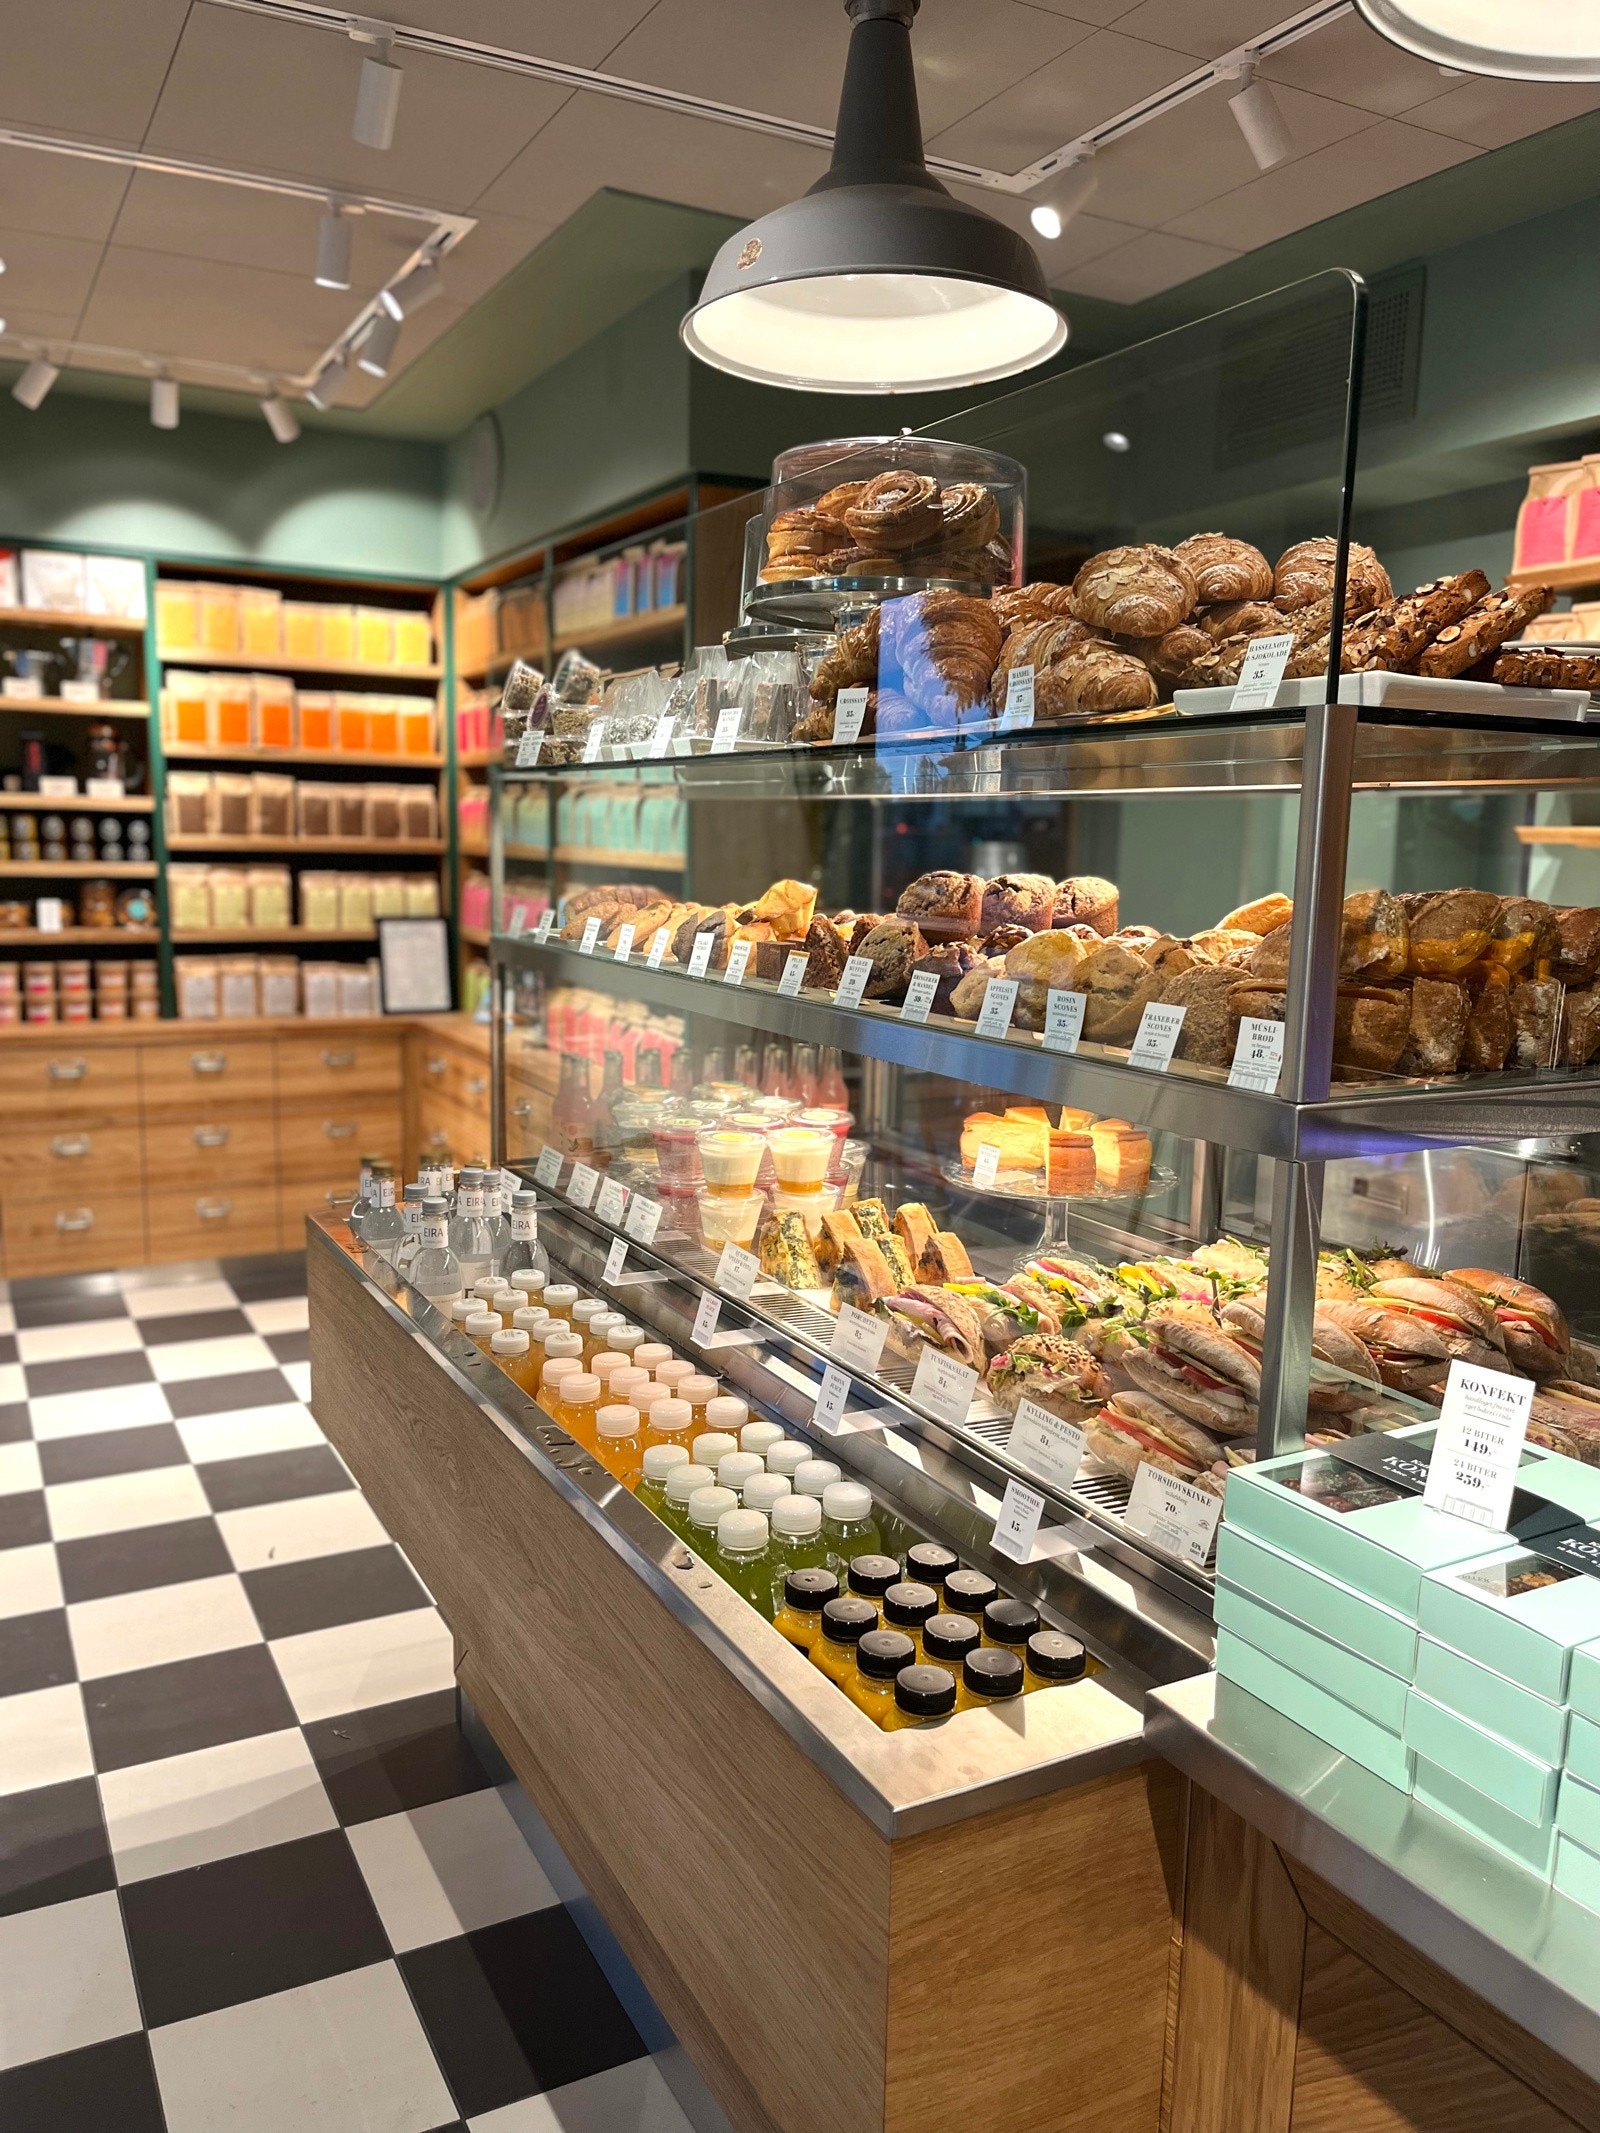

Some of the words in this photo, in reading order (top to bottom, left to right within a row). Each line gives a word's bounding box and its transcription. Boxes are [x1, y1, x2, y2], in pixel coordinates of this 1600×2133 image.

[1251, 650, 1288, 660] SJOKOLADE
[990, 986, 1013, 994] APPELSIN
[1053, 1003, 1078, 1012] SCONES
[1057, 996, 1076, 1004] ROSIN
[1147, 1022, 1173, 1032] SCONES
[423, 1227, 444, 1238] EIRA
[512, 1220, 531, 1230] EIRA
[930, 1354, 969, 1378] TUNFISKSALAT
[1460, 1378, 1527, 1406] KONFEKT
[1026, 1404, 1054, 1425] KYLLING
[1060, 1425, 1081, 1441] PESTO
[1462, 1426, 1473, 1435] 12
[1474, 1429, 1505, 1445] BITER
[1453, 1458, 1464, 1468] 24
[1466, 1462, 1498, 1479] BITER
[1147, 1468, 1213, 1507] TORSHOVSKINKE
[1011, 1486, 1040, 1508] SMOOTHIE
